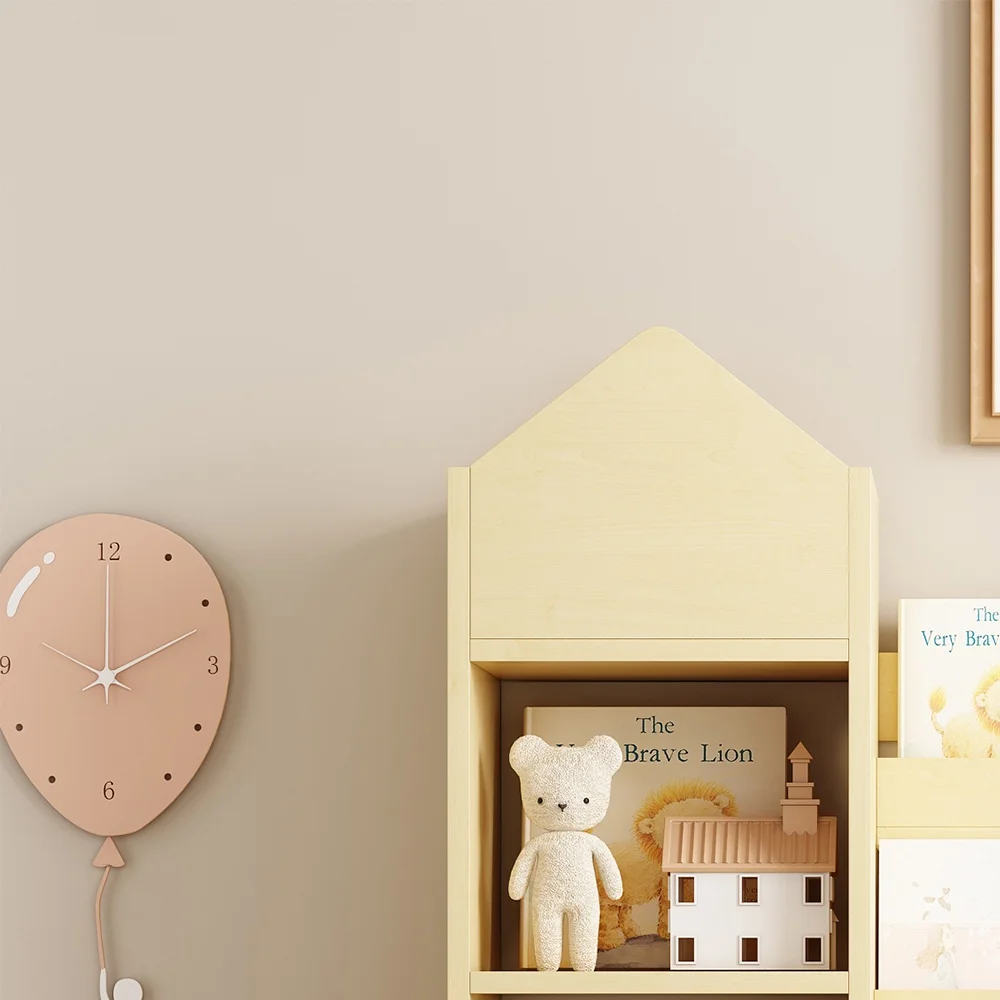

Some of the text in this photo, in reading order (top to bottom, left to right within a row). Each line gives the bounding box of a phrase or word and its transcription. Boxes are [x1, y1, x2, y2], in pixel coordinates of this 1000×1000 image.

[97, 541, 121, 561] 12
[973, 606, 1000, 622] The
[921, 630, 957, 653] Very
[0, 655, 11, 675] 9
[207, 655, 219, 675] 3
[635, 715, 675, 734] The
[623, 743, 754, 763] Brave Lion
[102, 780, 115, 801] 6
